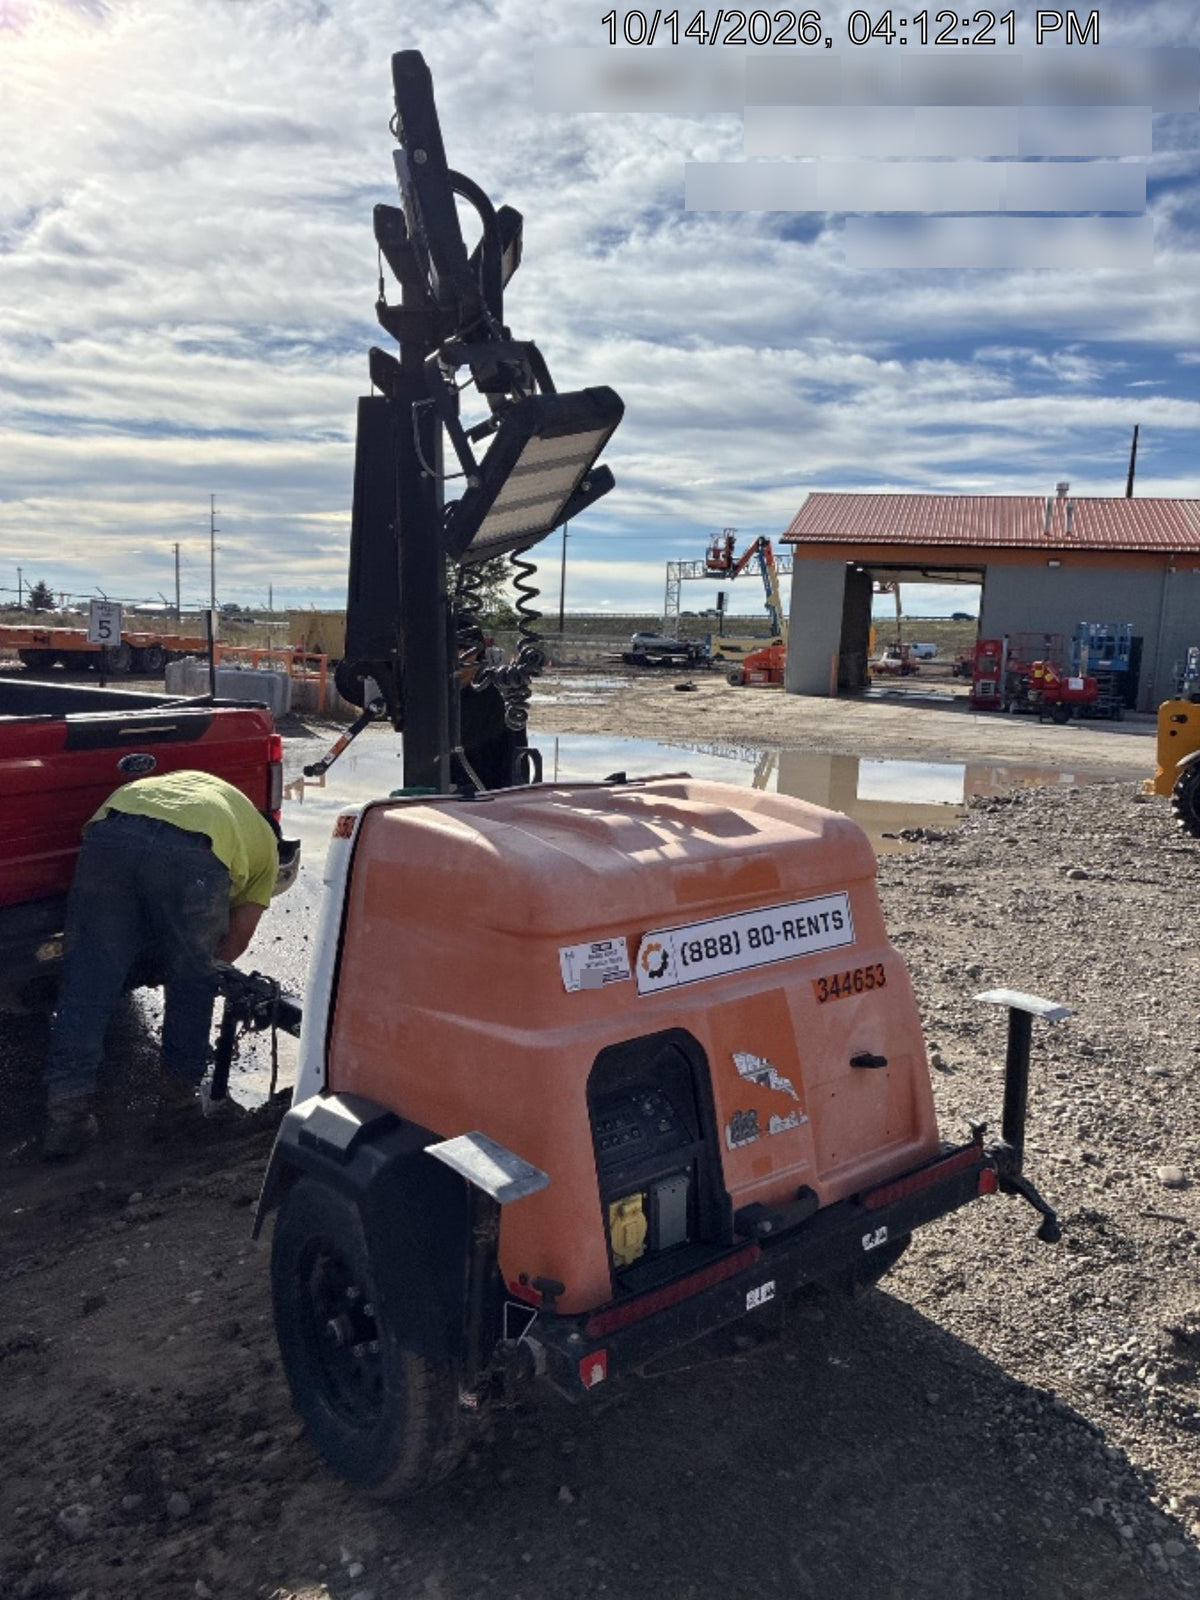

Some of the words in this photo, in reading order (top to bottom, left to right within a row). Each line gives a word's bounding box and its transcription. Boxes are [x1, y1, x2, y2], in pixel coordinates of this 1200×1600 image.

[98, 620, 112, 639] 5
[680, 930, 740, 966] (888)
[747, 910, 844, 949] 80-RENTS
[817, 963, 886, 1003] 344653
